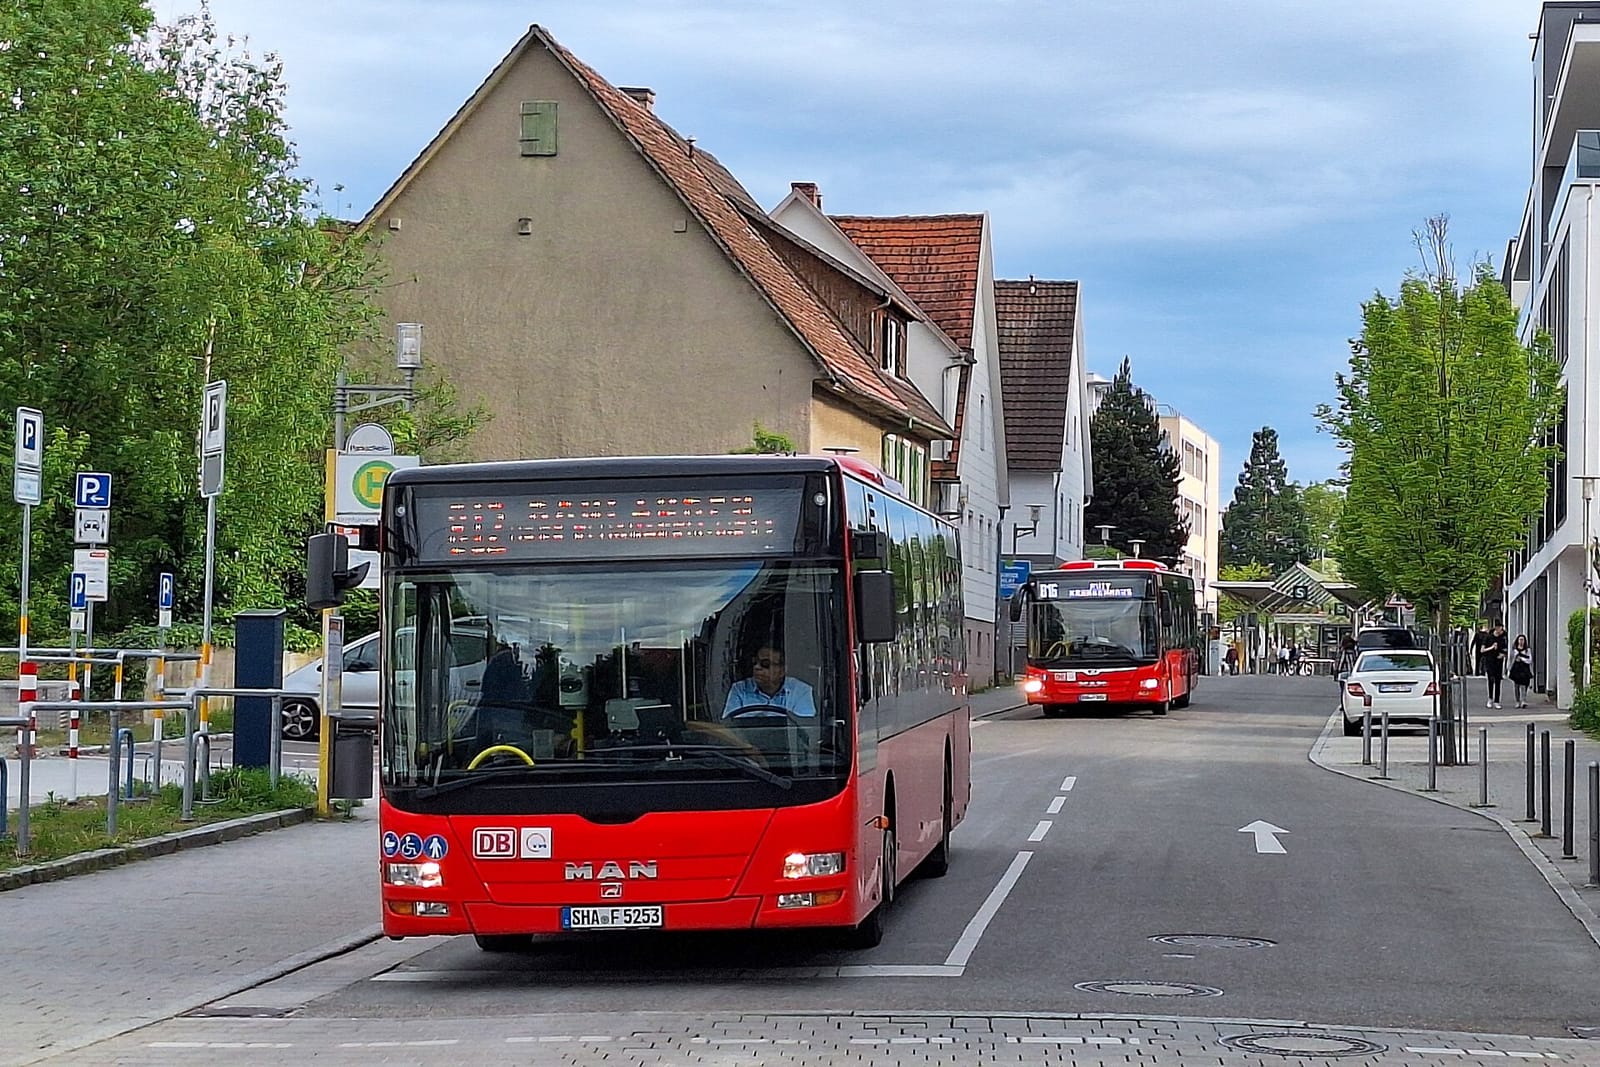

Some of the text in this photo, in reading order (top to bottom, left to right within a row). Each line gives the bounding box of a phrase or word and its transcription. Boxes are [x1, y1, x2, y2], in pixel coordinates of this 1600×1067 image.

[211, 399, 220, 427] P
[25, 422, 34, 446] P
[81, 477, 101, 503] P
[366, 471, 388, 497] H
[74, 576, 84, 604] P
[162, 578, 171, 604] P
[1295, 587, 1304, 598] S
[1337, 604, 1344, 614] S
[479, 833, 511, 853] DB
[565, 860, 658, 880] MAN
[572, 908, 660, 925] SHA F 5253
